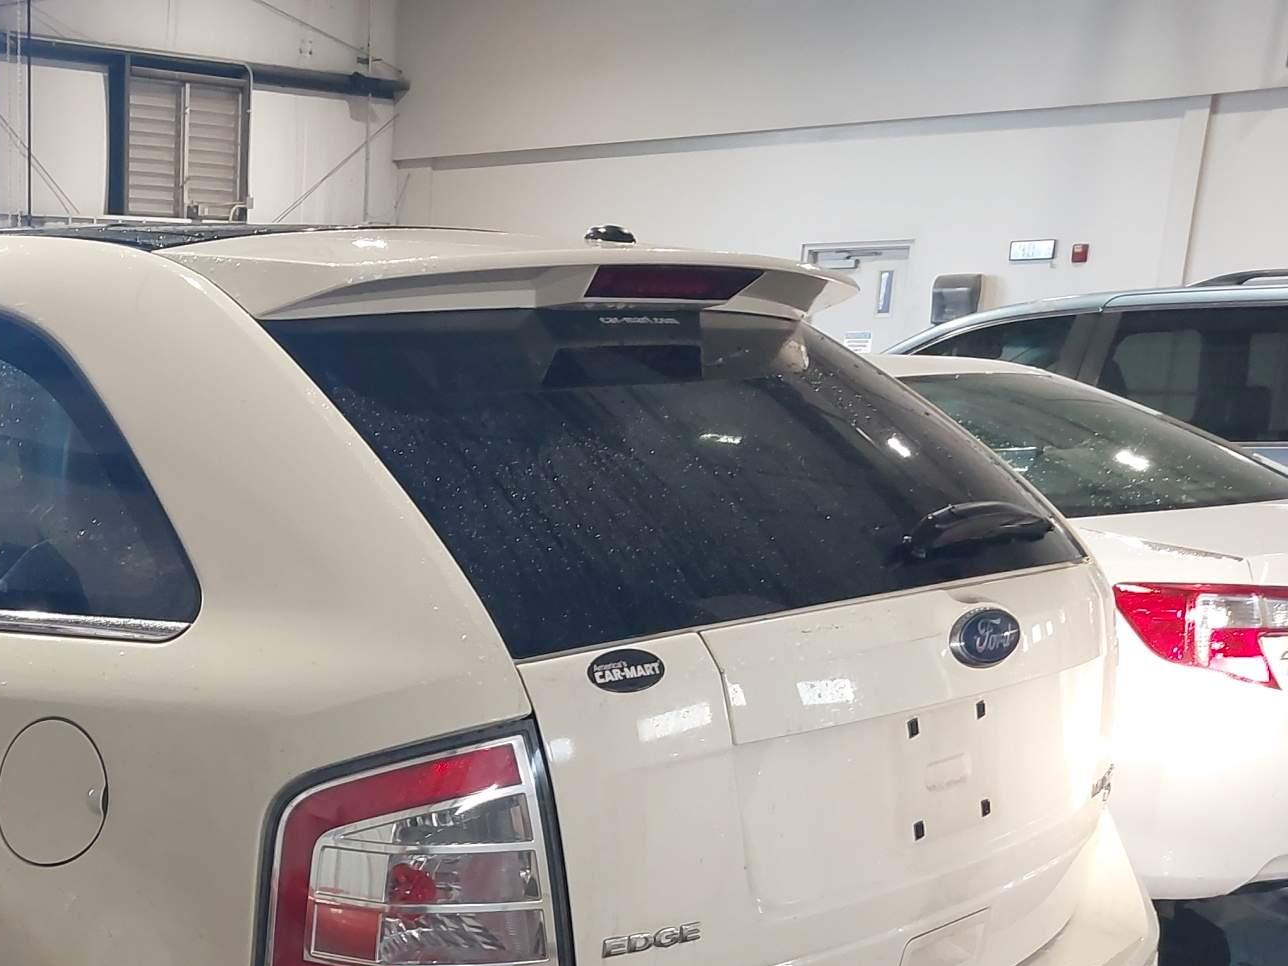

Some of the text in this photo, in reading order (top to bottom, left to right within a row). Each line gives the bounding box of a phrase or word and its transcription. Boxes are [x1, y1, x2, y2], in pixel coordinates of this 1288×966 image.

[975, 618, 1019, 653] Ford
[594, 661, 660, 684] CAR-MART
[602, 921, 701, 958] EDGE
